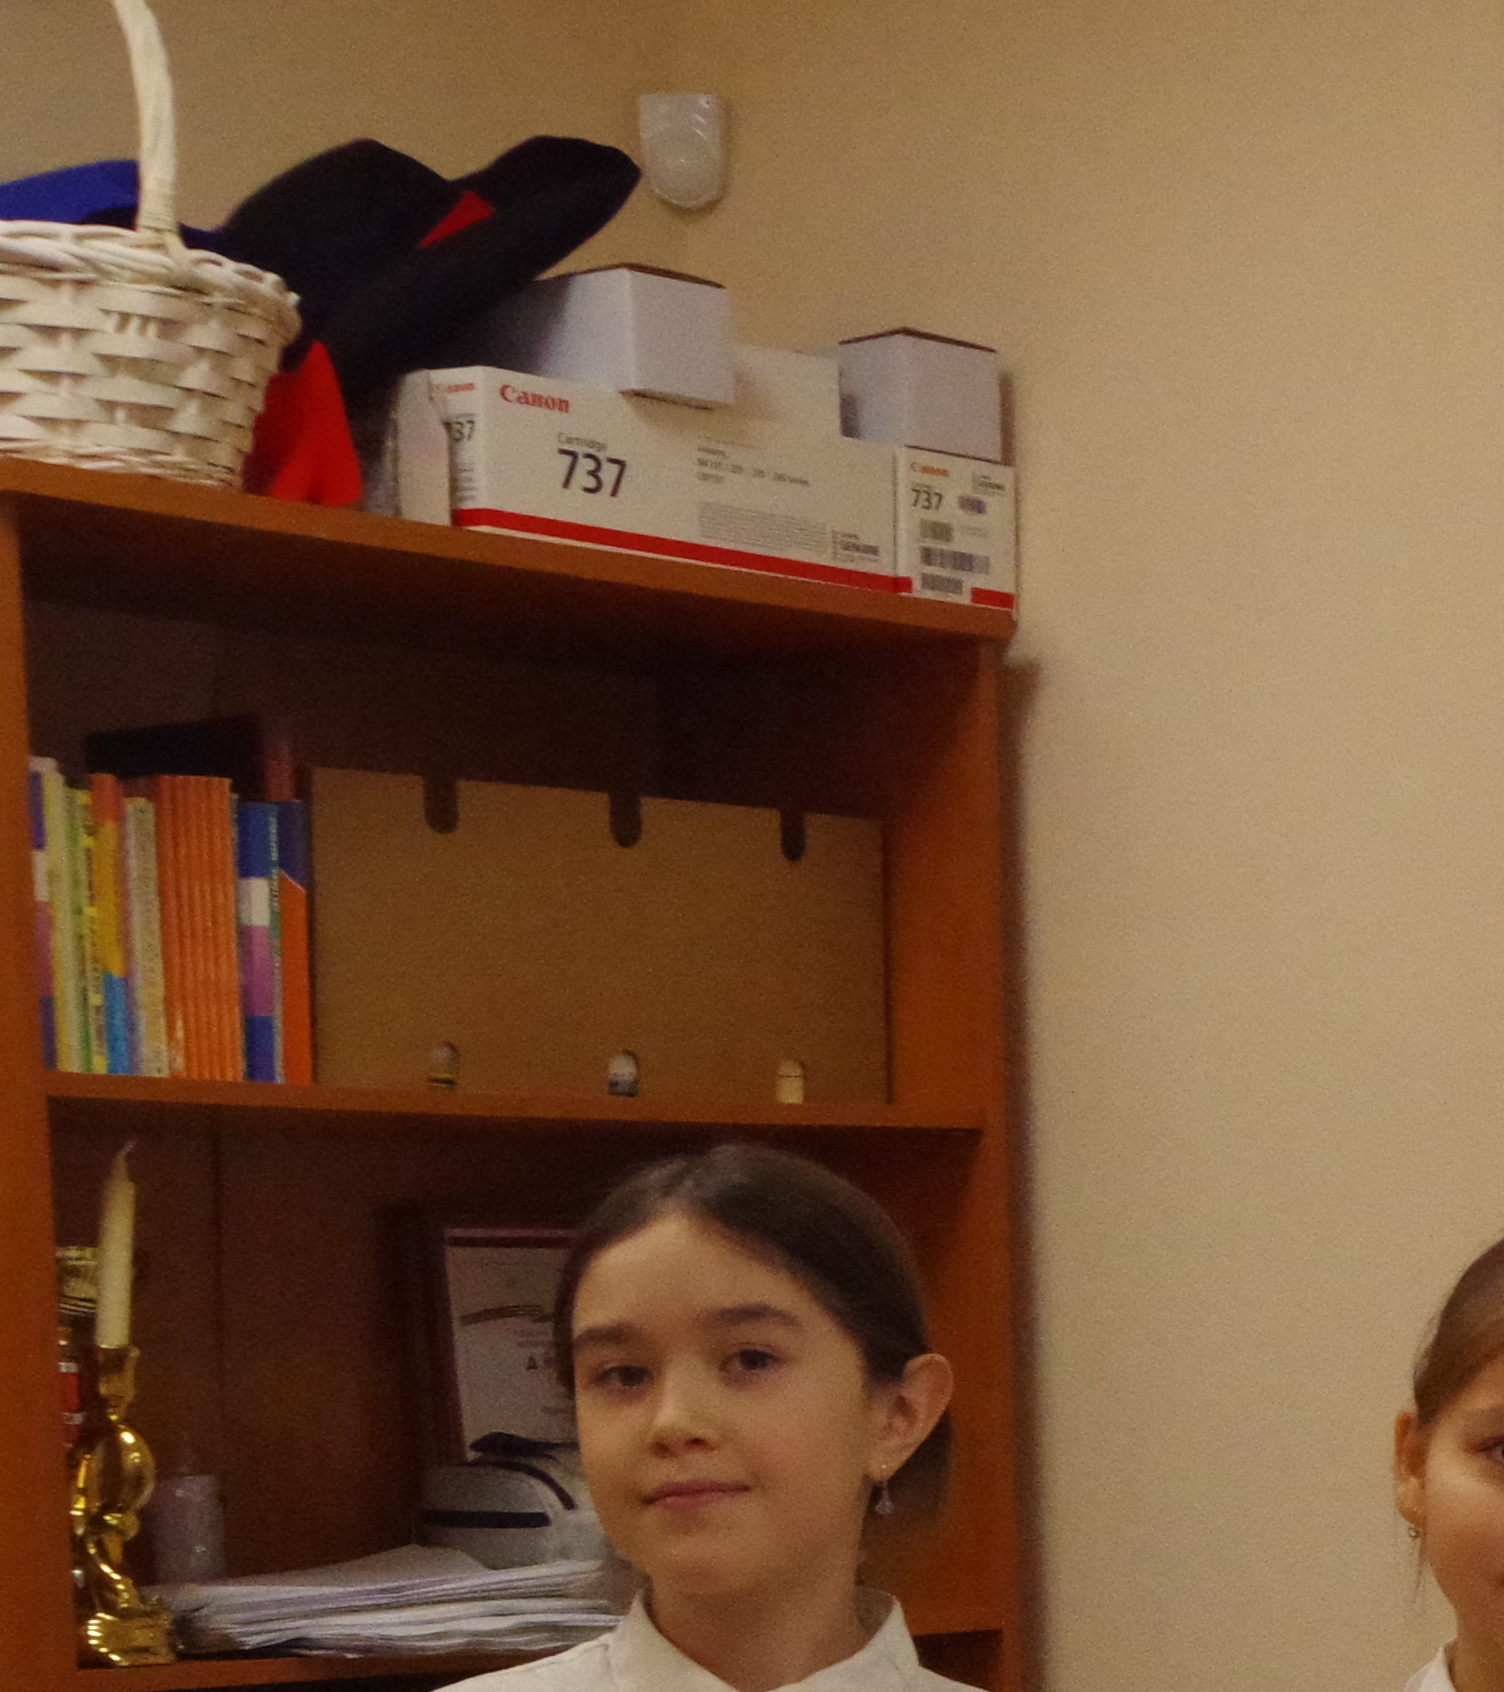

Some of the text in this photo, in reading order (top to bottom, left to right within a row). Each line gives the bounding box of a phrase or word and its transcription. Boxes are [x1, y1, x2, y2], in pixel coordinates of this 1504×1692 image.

[500, 384, 571, 413] Canon
[557, 448, 627, 498] 737
[911, 488, 943, 511] 737
